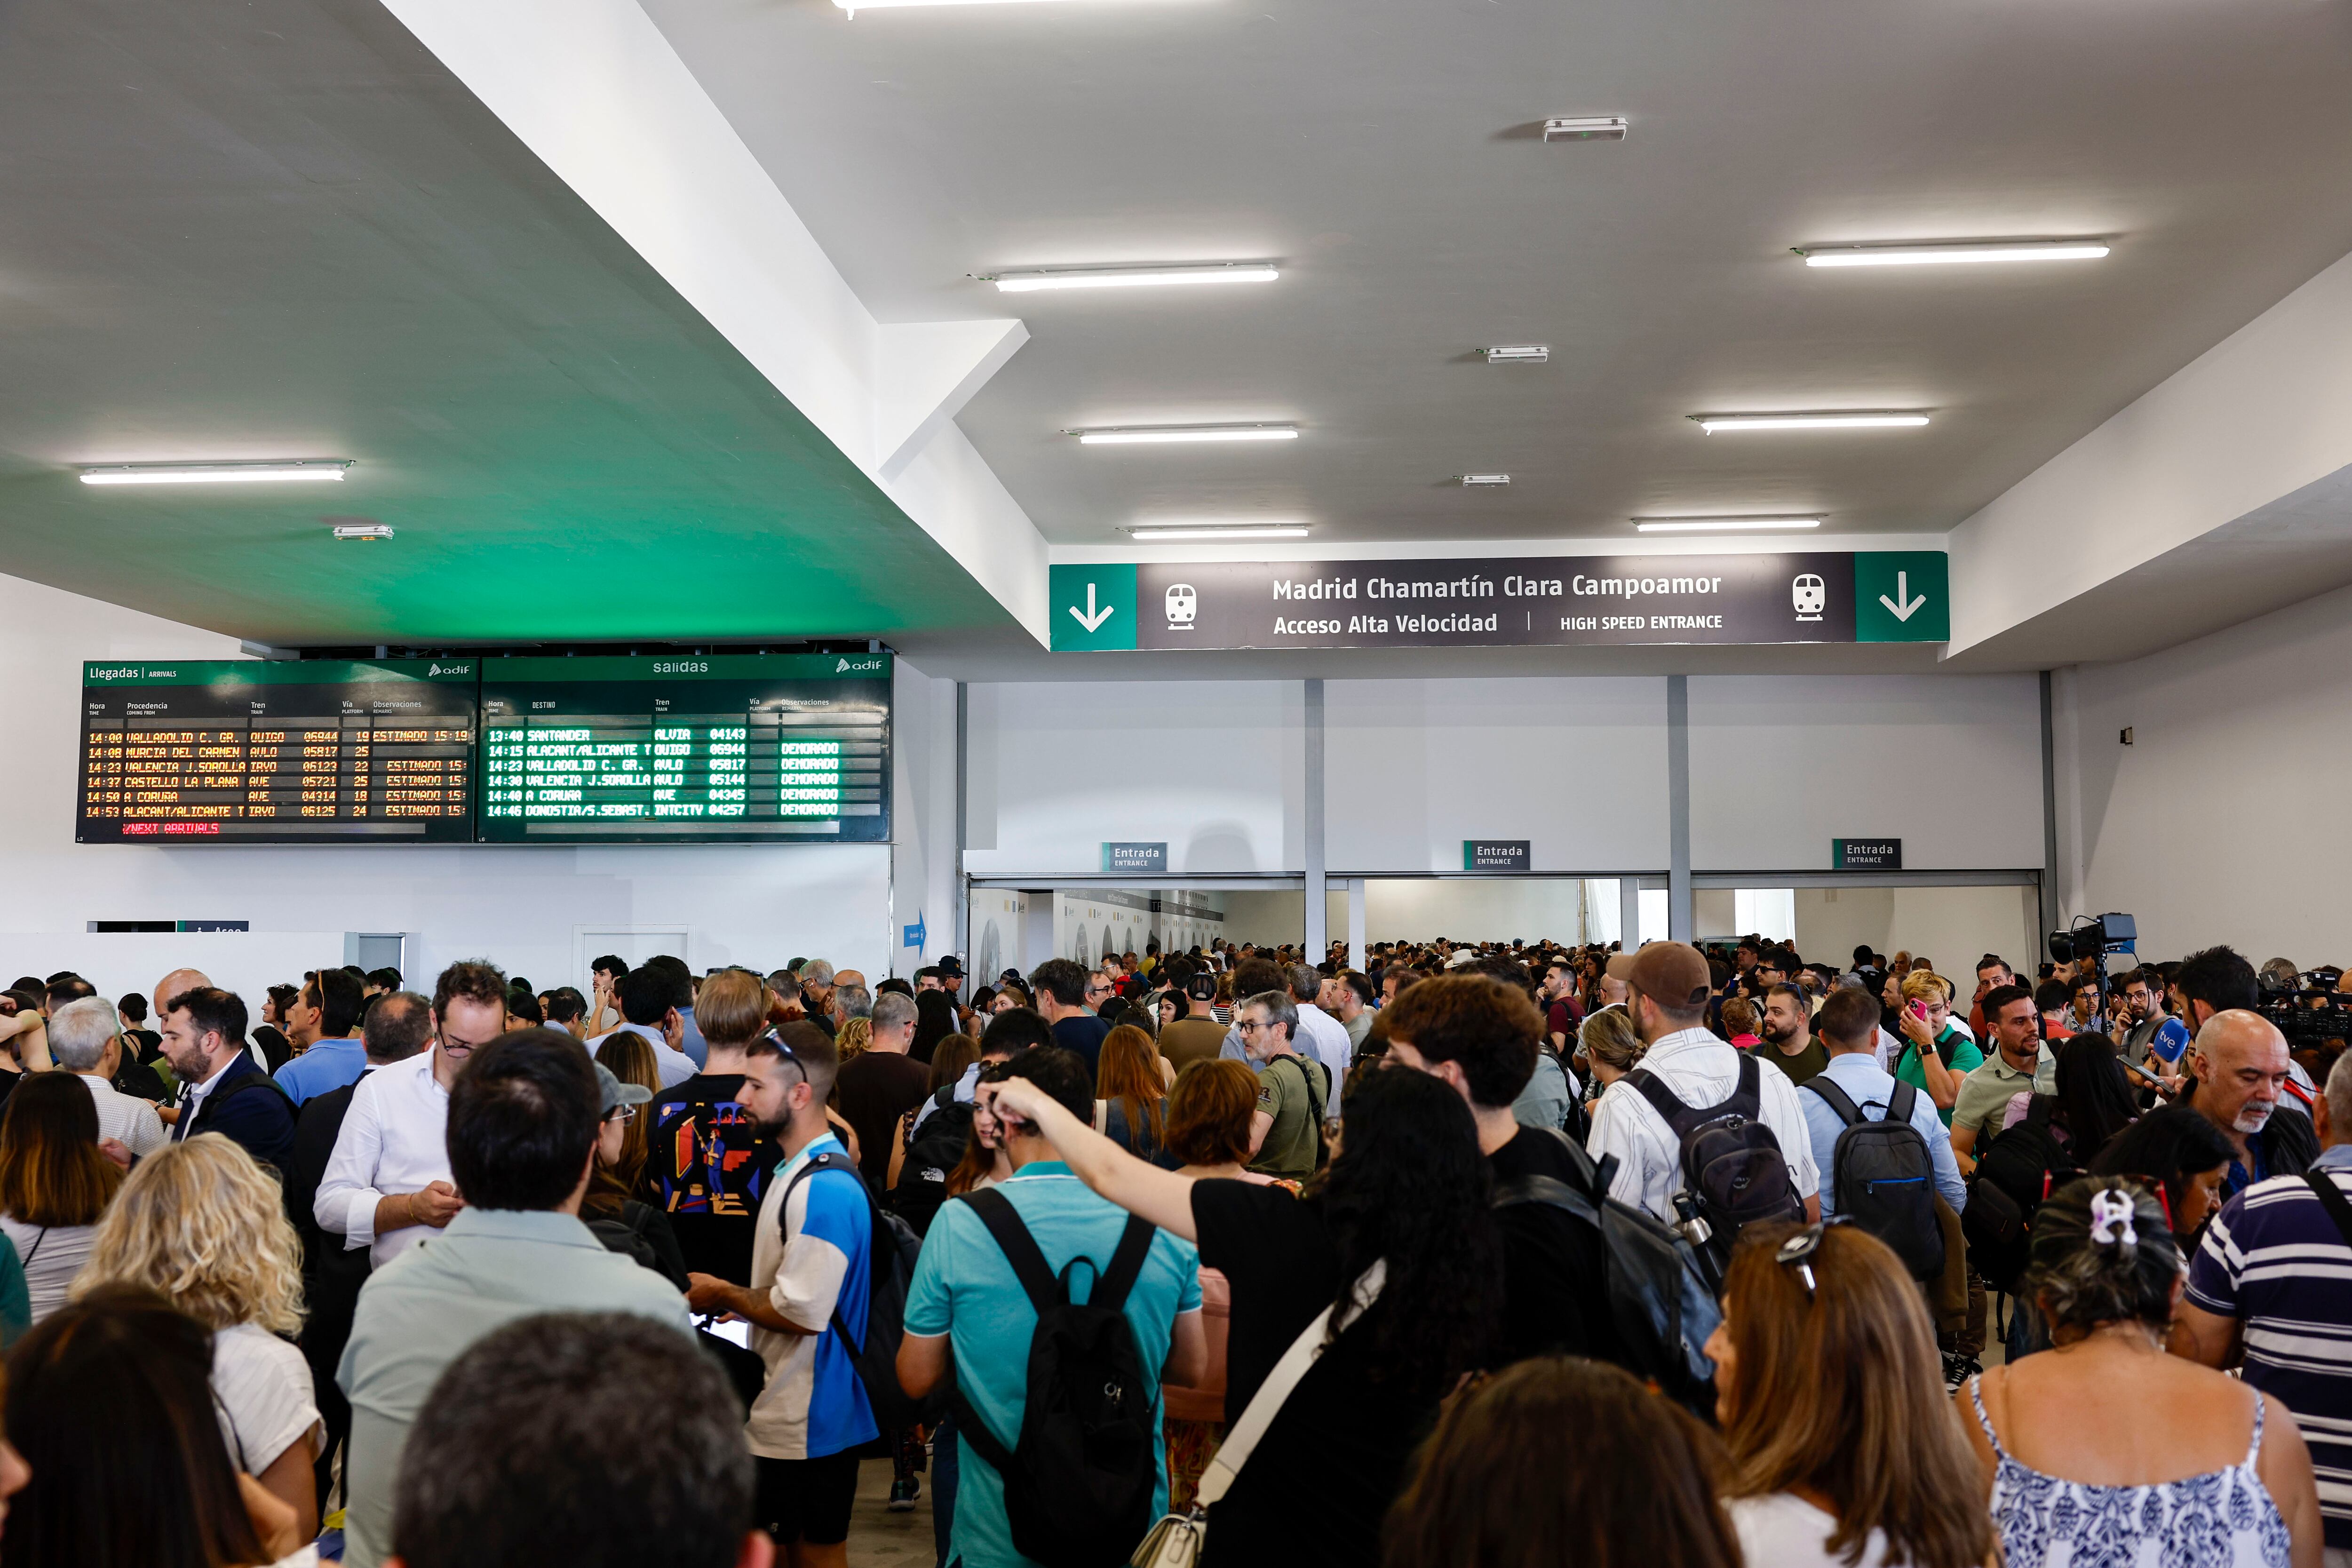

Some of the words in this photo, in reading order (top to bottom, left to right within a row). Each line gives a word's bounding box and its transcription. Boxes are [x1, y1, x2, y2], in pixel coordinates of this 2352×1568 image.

[1273, 576, 1357, 600] Madrid
[1367, 575, 1493, 598] Chamartín
[1505, 576, 1562, 596] Clara
[1573, 573, 1721, 599] Campoamor
[1274, 617, 1341, 634] Acceso
[1349, 616, 1388, 633] Alta
[1396, 613, 1496, 632] Velocidad
[1561, 617, 1596, 629] HIGH
[1602, 617, 1645, 629] SPEED
[1651, 615, 1722, 629] ENTRANCE
[443, 665, 470, 675] adif
[653, 661, 708, 673] salidas
[852, 661, 882, 670] adif
[90, 668, 138, 680] Llegadas
[90, 733, 122, 743] 14:00
[127, 733, 193, 743] VALLADOLID
[199, 732, 211, 742] C.
[220, 732, 238, 742] GR.
[251, 732, 284, 742] OUIGO
[304, 732, 337, 742] 06944
[357, 732, 369, 741] 19
[373, 731, 427, 741] ESTIMADO
[435, 731, 467, 741] 15:19
[490, 731, 523, 741] 13:40
[528, 730, 589, 741] SANTANDER
[655, 729, 690, 740] ALVIA
[710, 729, 746, 739] 04143
[89, 748, 121, 758] 14:08
[126, 748, 166, 758] MURCIA
[172, 748, 192, 757] DEL
[199, 748, 240, 757] CARMEN
[250, 747, 277, 757] AVLO
[304, 747, 337, 756] 05817
[356, 747, 368, 756] 25
[490, 746, 523, 756] 14:15
[645, 744, 651, 755] T
[655, 744, 690, 755] OUIGO
[710, 744, 745, 754] 06944
[782, 743, 838, 754] DEMORADO
[89, 763, 121, 772] 14:23
[126, 763, 179, 772] VALENCIA
[186, 762, 246, 772] J.SOROLLA
[251, 762, 277, 772] IRYO
[303, 762, 337, 772] 06123
[355, 761, 367, 771] 22
[387, 761, 442, 771] ESTIMADO
[490, 761, 522, 771] 14:23
[527, 760, 596, 771] VALLADOLID
[602, 760, 615, 770] C.
[623, 760, 643, 770] GR.
[654, 759, 683, 770] AVLO
[710, 759, 745, 770] 05817
[781, 758, 838, 769] DEMORADO
[88, 778, 121, 787] 14:37
[125, 777, 179, 787] CASTELLO
[185, 777, 199, 787] LA
[205, 777, 238, 787] PLANA
[249, 777, 270, 787] AVE
[302, 777, 336, 786] 05721
[354, 776, 367, 786] 25
[387, 776, 441, 786] ESTIMADO
[489, 776, 522, 786] 14:30
[526, 775, 581, 786] VALENCIA
[588, 774, 651, 785] J.SOROLLA
[654, 774, 683, 785] AVLO
[710, 774, 745, 785] 05144
[781, 773, 838, 784] DEMORADO
[87, 792, 120, 802] 14:50
[124, 792, 132, 802] A
[249, 792, 269, 801] AVE
[302, 791, 335, 801] 04314
[355, 791, 367, 801] 18
[386, 791, 440, 801] ESTIMADO
[489, 791, 522, 801] 14:40
[526, 791, 533, 801] A
[654, 790, 675, 800] AVE
[709, 789, 745, 800] 04345
[781, 789, 838, 799] DEMORADO
[87, 807, 119, 817] 14:53
[238, 806, 244, 816] T
[249, 806, 275, 816] IRYO
[302, 806, 335, 816] 06125
[353, 806, 366, 816] 24
[386, 805, 440, 815] ESTIMADO
[489, 805, 521, 816] 14:46
[655, 805, 703, 815] INTCITY
[709, 804, 745, 815] 04257
[781, 804, 838, 814] DEMORADO
[1115, 848, 1159, 857] Entrada
[1478, 846, 1522, 856] Entrada
[1847, 844, 1893, 854] Entrada
[2160, 1031, 2176, 1049] tve
